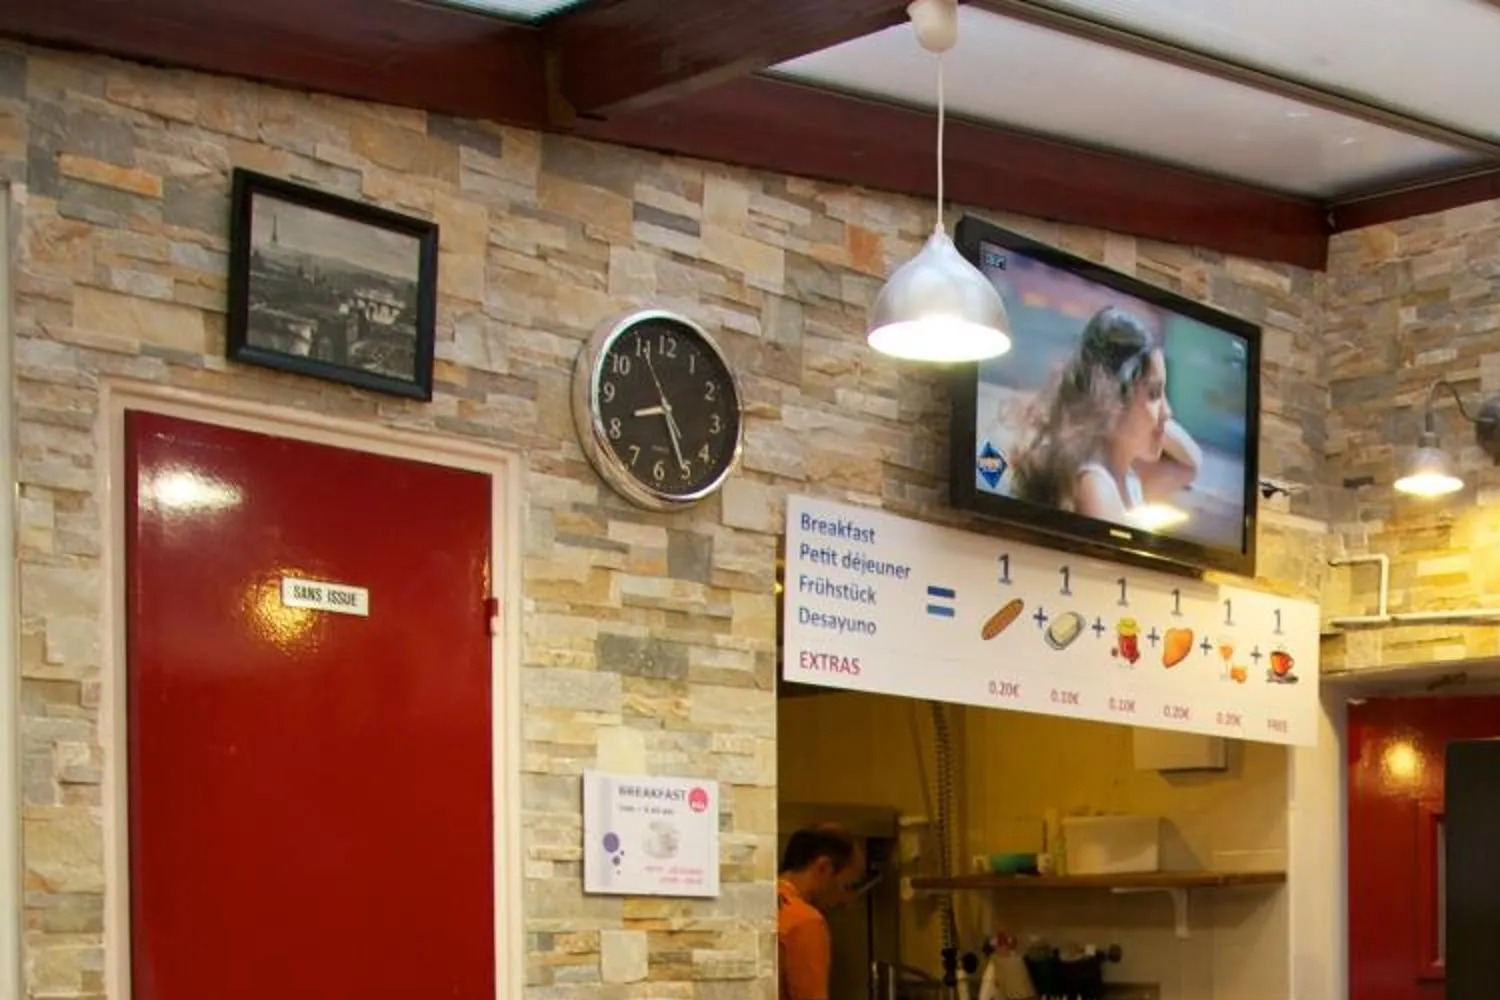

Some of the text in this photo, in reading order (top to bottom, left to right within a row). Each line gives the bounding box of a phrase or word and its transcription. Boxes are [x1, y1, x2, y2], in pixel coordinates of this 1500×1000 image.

[659, 334, 678, 359] 12
[611, 352, 631, 376] 10
[689, 354, 696, 375] 1
[603, 382, 616, 402] 9
[704, 381, 715, 401] 2
[609, 417, 622, 440] 8
[709, 415, 721, 434] 3
[628, 445, 641, 466] 7
[698, 444, 710, 464] 4
[653, 460, 665, 481] 6
[680, 460, 692, 480] 5
[800, 512, 876, 545] Breakfast
[799, 542, 912, 581] Petit déjeuner
[998, 553, 1013, 586] 1
[799, 575, 877, 606] Frühstück
[1058, 565, 1073, 597] 1
[1116, 577, 1130, 608] 1
[294, 585, 358, 606] SANS ISSUE
[1170, 588, 1184, 617] 1
[799, 606, 877, 637] Desayuno
[1223, 598, 1237, 627] 1
[1273, 608, 1286, 636] 1
[799, 651, 862, 676] EXTRAS
[988, 680, 1021, 698] 0.20€
[619, 785, 686, 801] BREAKFAST
